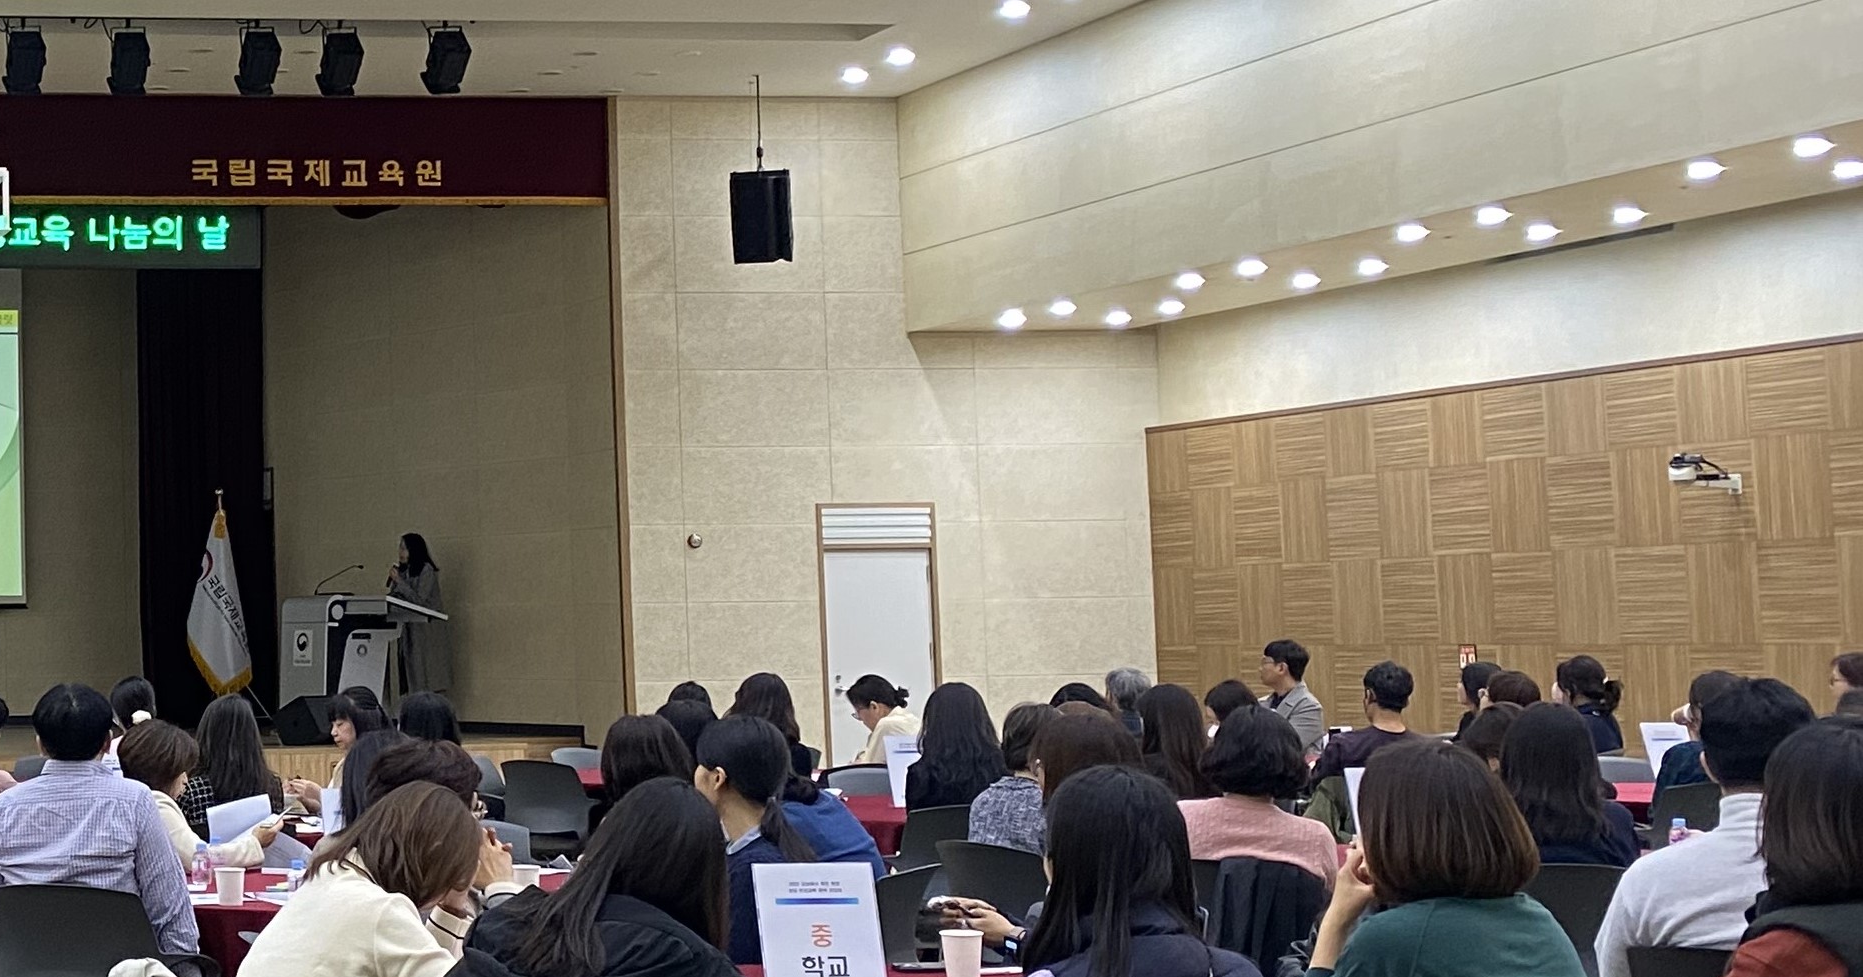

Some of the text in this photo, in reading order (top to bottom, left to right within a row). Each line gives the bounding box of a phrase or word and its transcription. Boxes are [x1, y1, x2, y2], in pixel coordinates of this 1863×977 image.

[191, 159, 441, 187] 국립국제교육원
[89, 214, 183, 251] 나눔의
[198, 214, 230, 251] 날
[811, 924, 833, 948] 중
